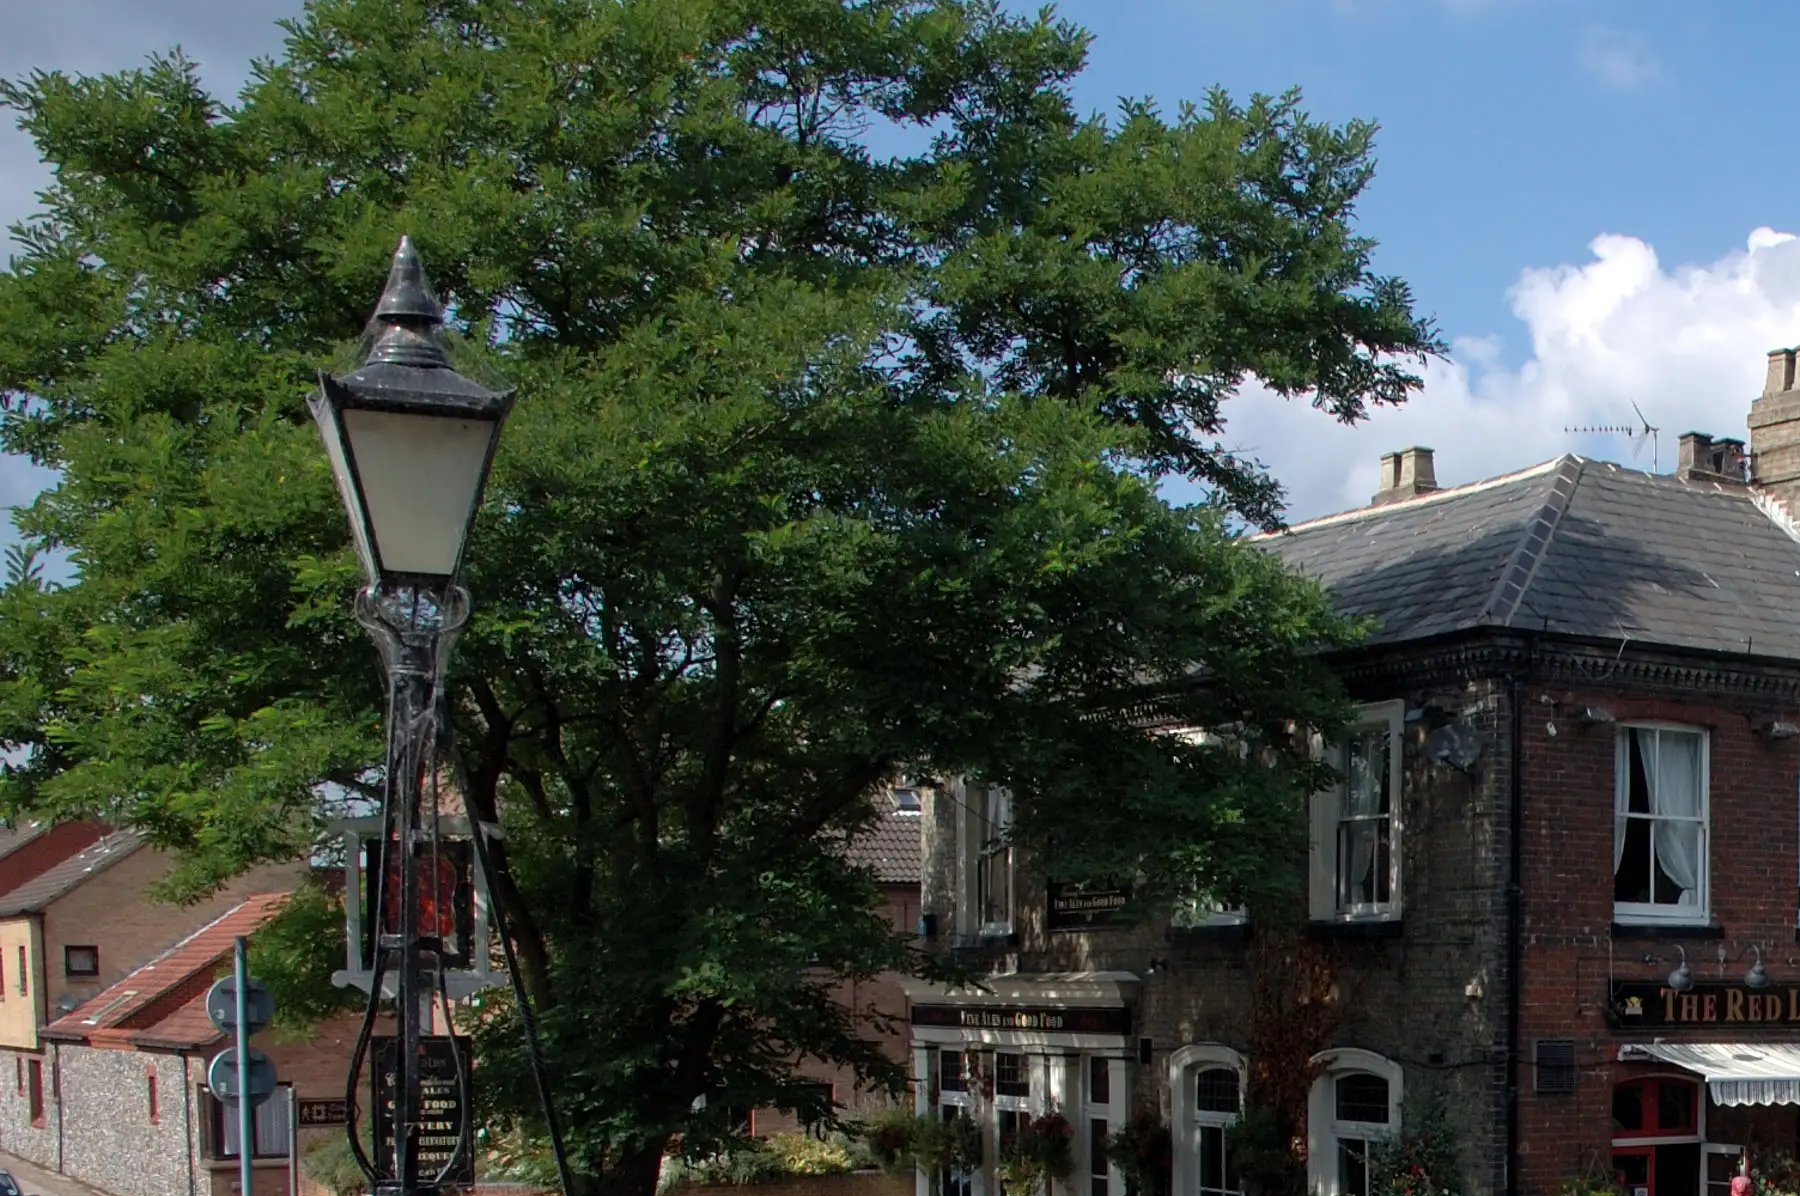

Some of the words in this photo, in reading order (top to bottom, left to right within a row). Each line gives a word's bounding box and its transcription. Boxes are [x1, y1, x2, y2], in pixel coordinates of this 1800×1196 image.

[1660, 987, 1717, 1023] THE
[1725, 988, 1782, 1022] RED
[1039, 1011, 1063, 1029] FOOD
[424, 1100, 457, 1109] FOOD
